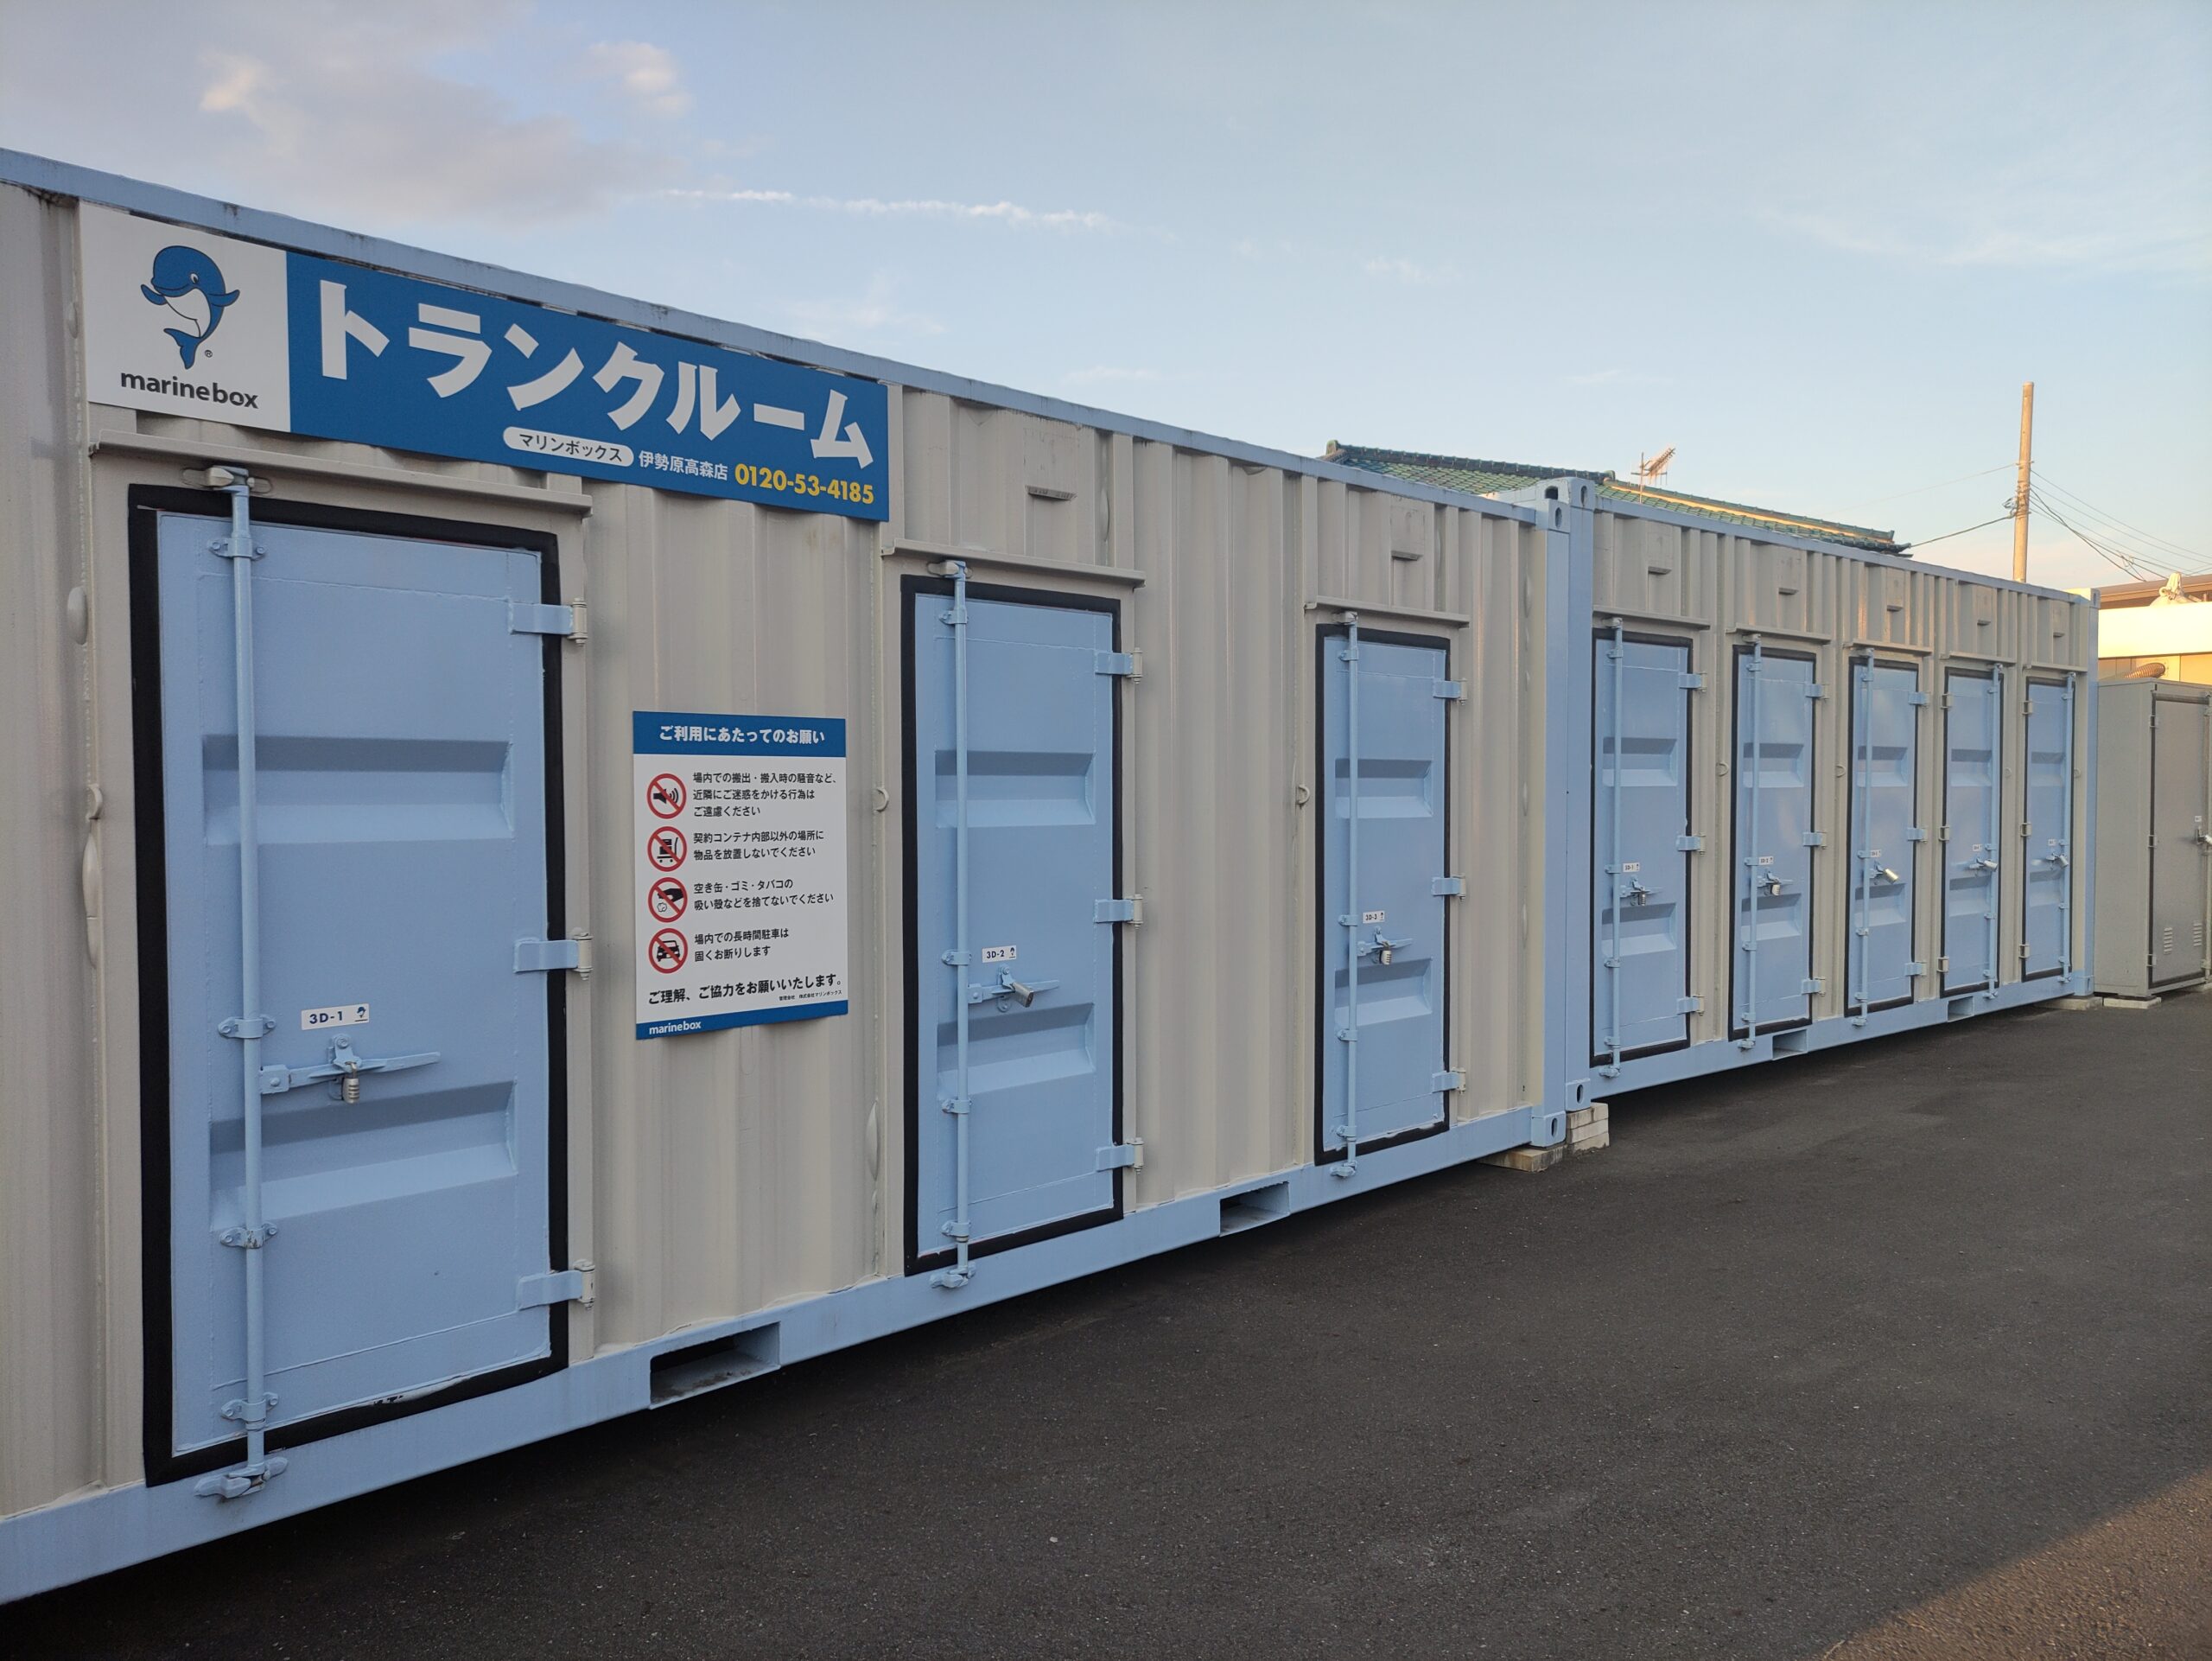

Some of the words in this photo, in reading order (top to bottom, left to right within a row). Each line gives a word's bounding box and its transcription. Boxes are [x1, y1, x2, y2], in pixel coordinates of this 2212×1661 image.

[320, 279, 874, 469] トランクルーム
[120, 371, 258, 410] marinebox
[518, 433, 623, 462] マリンボックス
[639, 449, 728, 481] 伊勢原高森店
[734, 462, 874, 505] 0120-53-4185
[659, 725, 825, 745] ご利用にあたってのお願い
[692, 788, 815, 800] 近隣にご迷惑をかける行為は
[694, 805, 760, 817] ご遠慮ください
[693, 830, 824, 843] 契約コンテナ内部以外の場所に
[694, 847, 816, 861] 物品を放置しないでください
[694, 879, 793, 894] 空き缶・ゴミ・タバコの
[694, 893, 834, 911] 吸い殻などを捨てないでください
[695, 927, 789, 945] 場内での長時間駐車は
[695, 945, 771, 962] 固くお断りします
[986, 949, 1005, 959] 3D-2
[309, 1010, 343, 1024] 3D-1
[649, 1020, 702, 1035] marinebox
